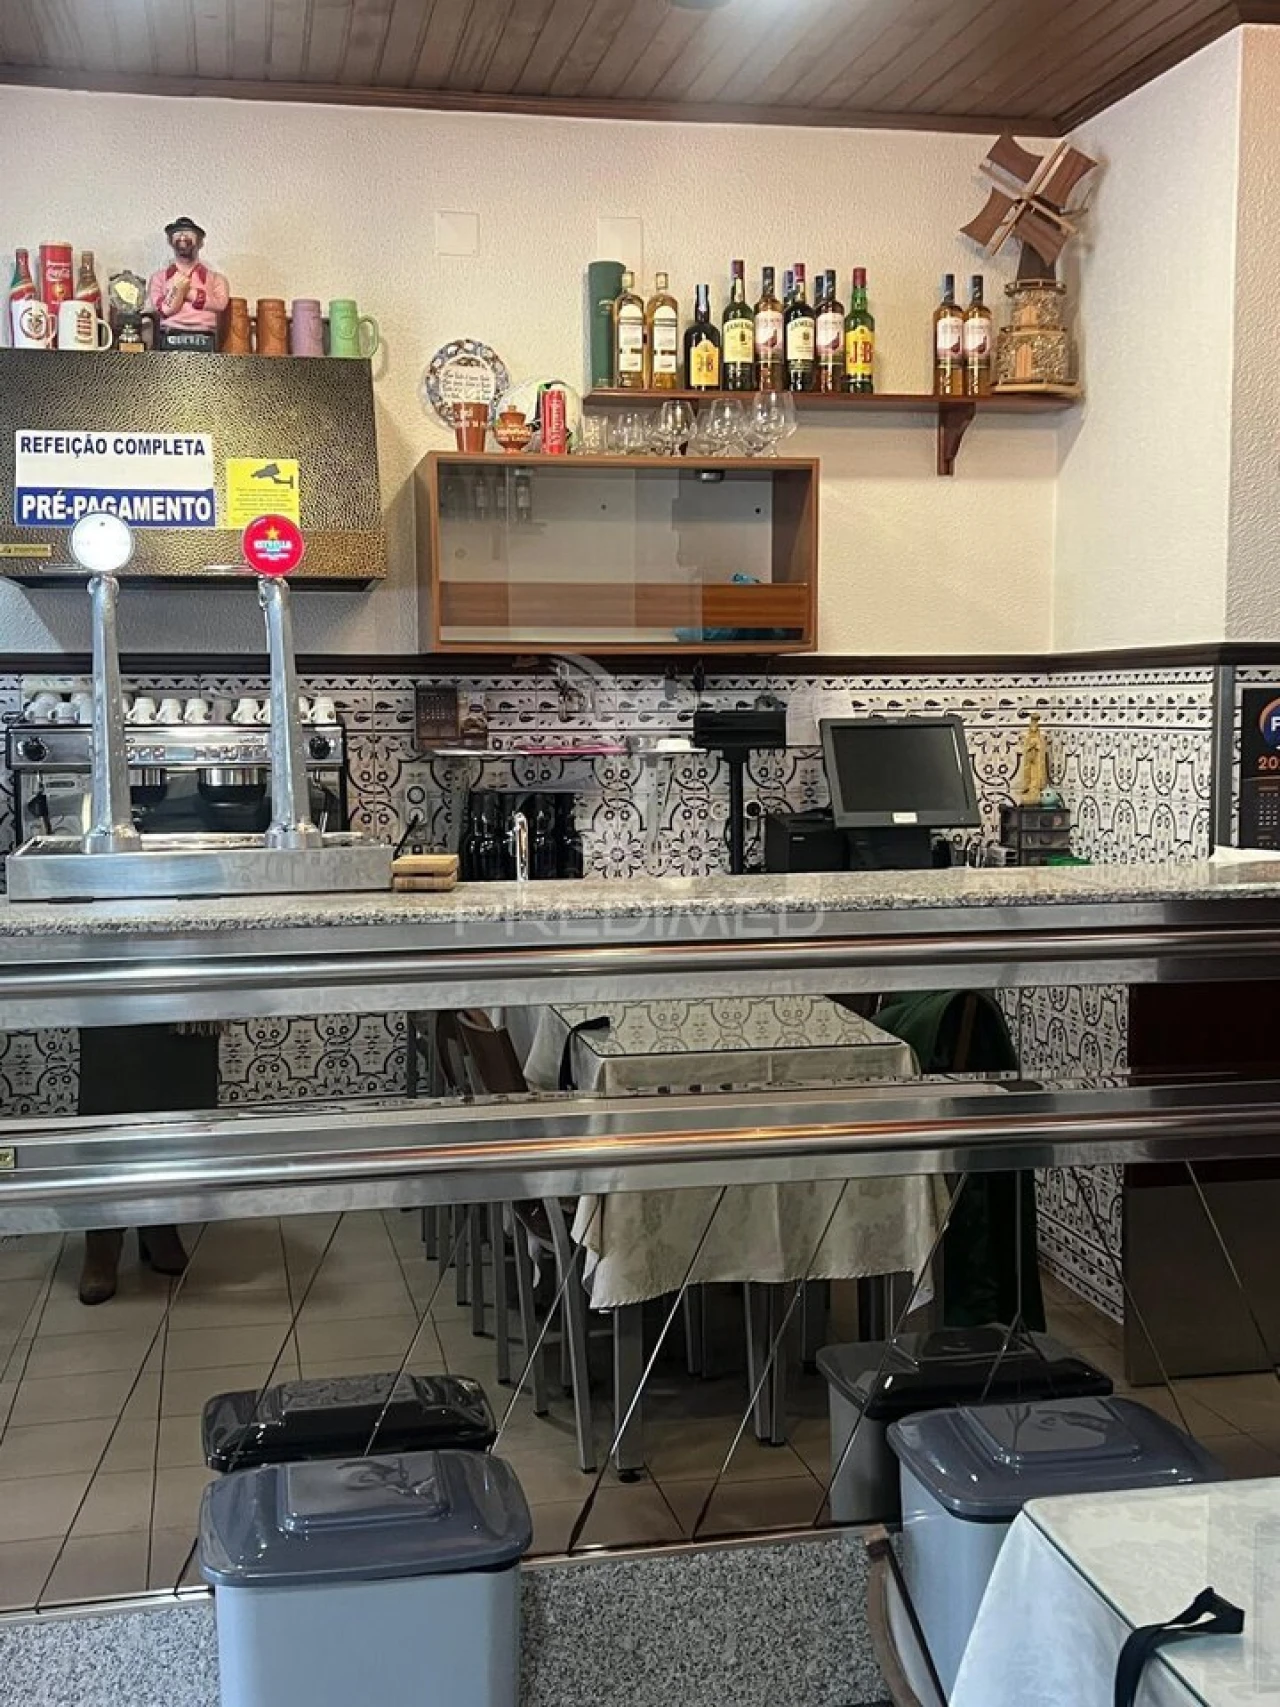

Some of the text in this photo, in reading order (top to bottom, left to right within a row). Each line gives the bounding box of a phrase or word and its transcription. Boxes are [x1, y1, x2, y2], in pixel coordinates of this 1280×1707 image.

[20, 434, 206, 458] REFEIÇÃO COMPLETA
[22, 489, 211, 520] PRÉ-PAGAMENTO
[1258, 756, 1280, 770] 20
